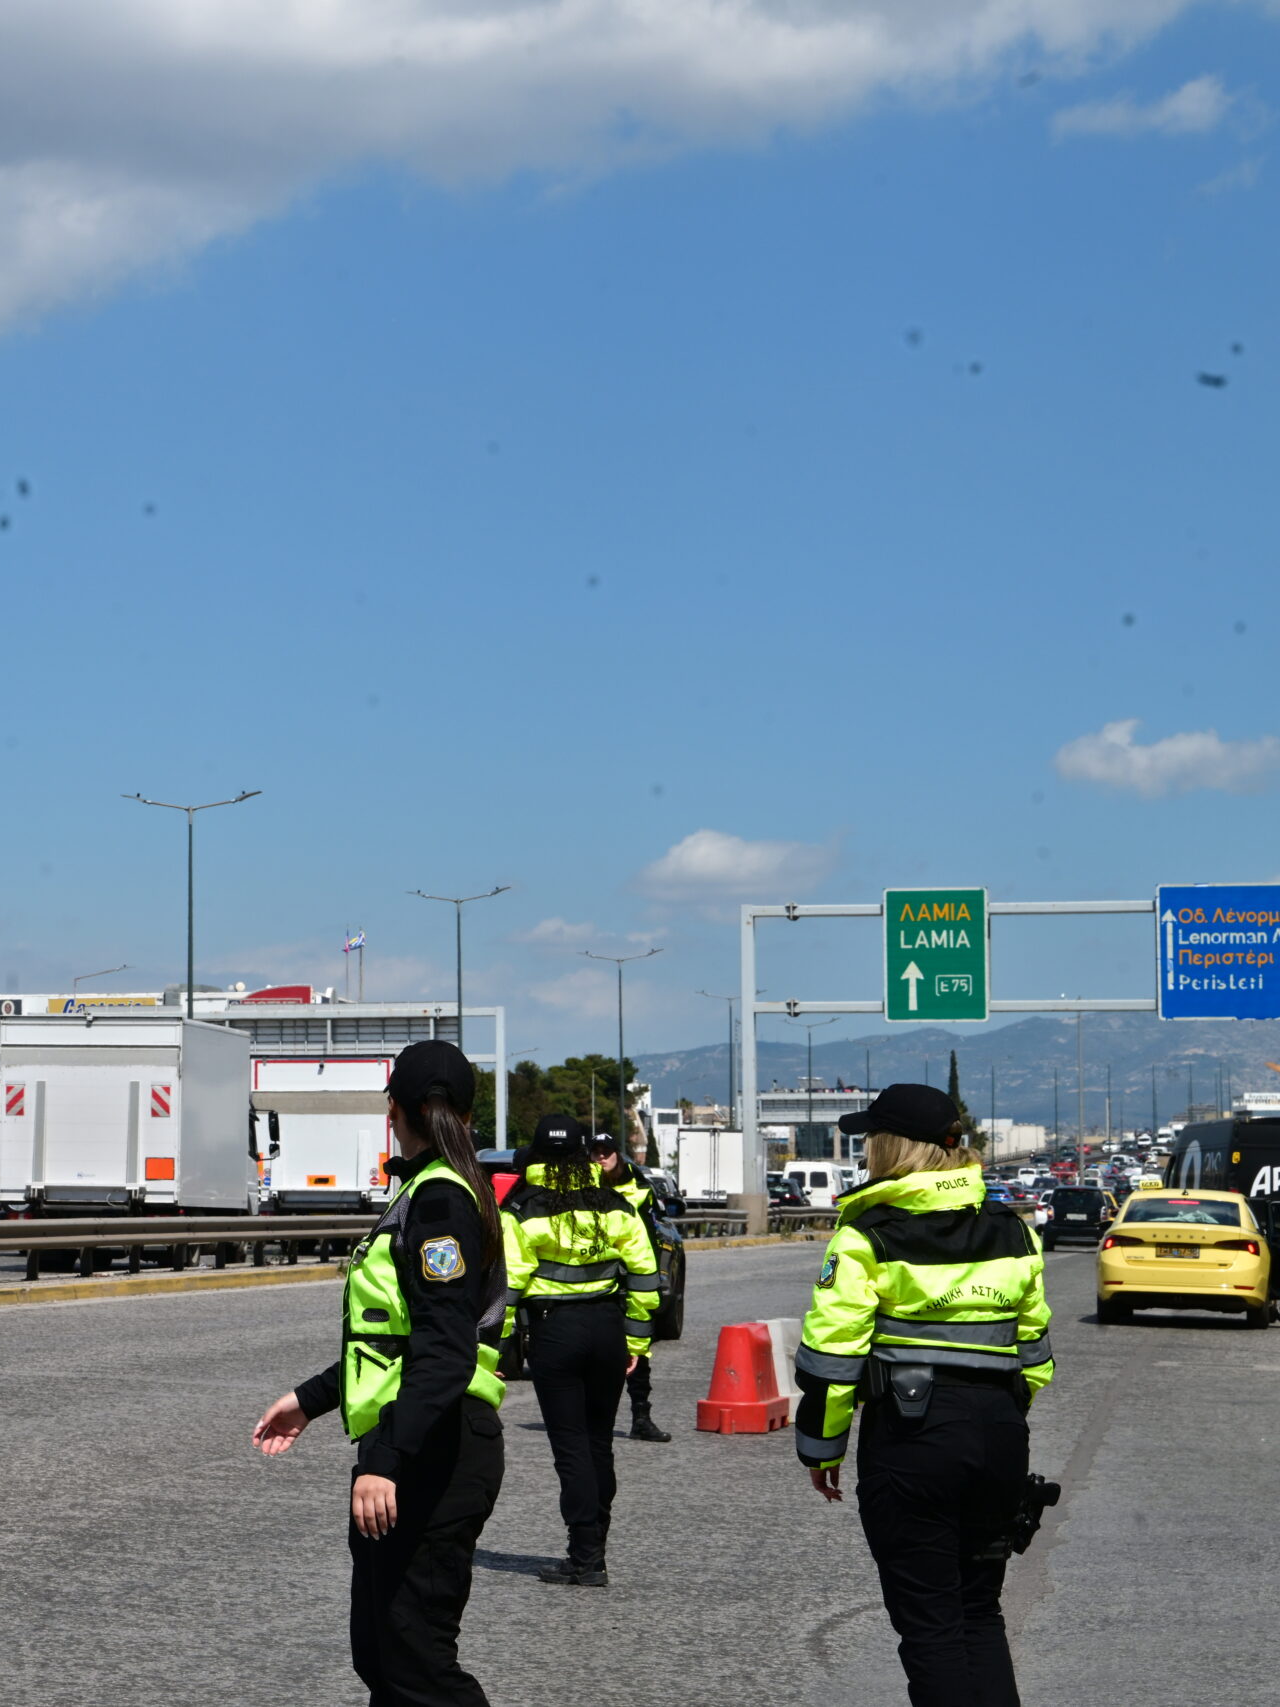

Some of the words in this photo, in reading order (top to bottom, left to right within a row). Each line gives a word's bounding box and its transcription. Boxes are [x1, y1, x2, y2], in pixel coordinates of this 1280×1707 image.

[899, 903, 972, 922] ΛΑΜΙΑ
[1179, 908, 1208, 924] Οδ.
[900, 930, 971, 949] LAMIA
[1178, 929, 1268, 945] Lenorman
[1178, 949, 1274, 968] Περιστέρι
[1179, 973, 1263, 990] Peristeri
[935, 1176, 970, 1192] POLICE
